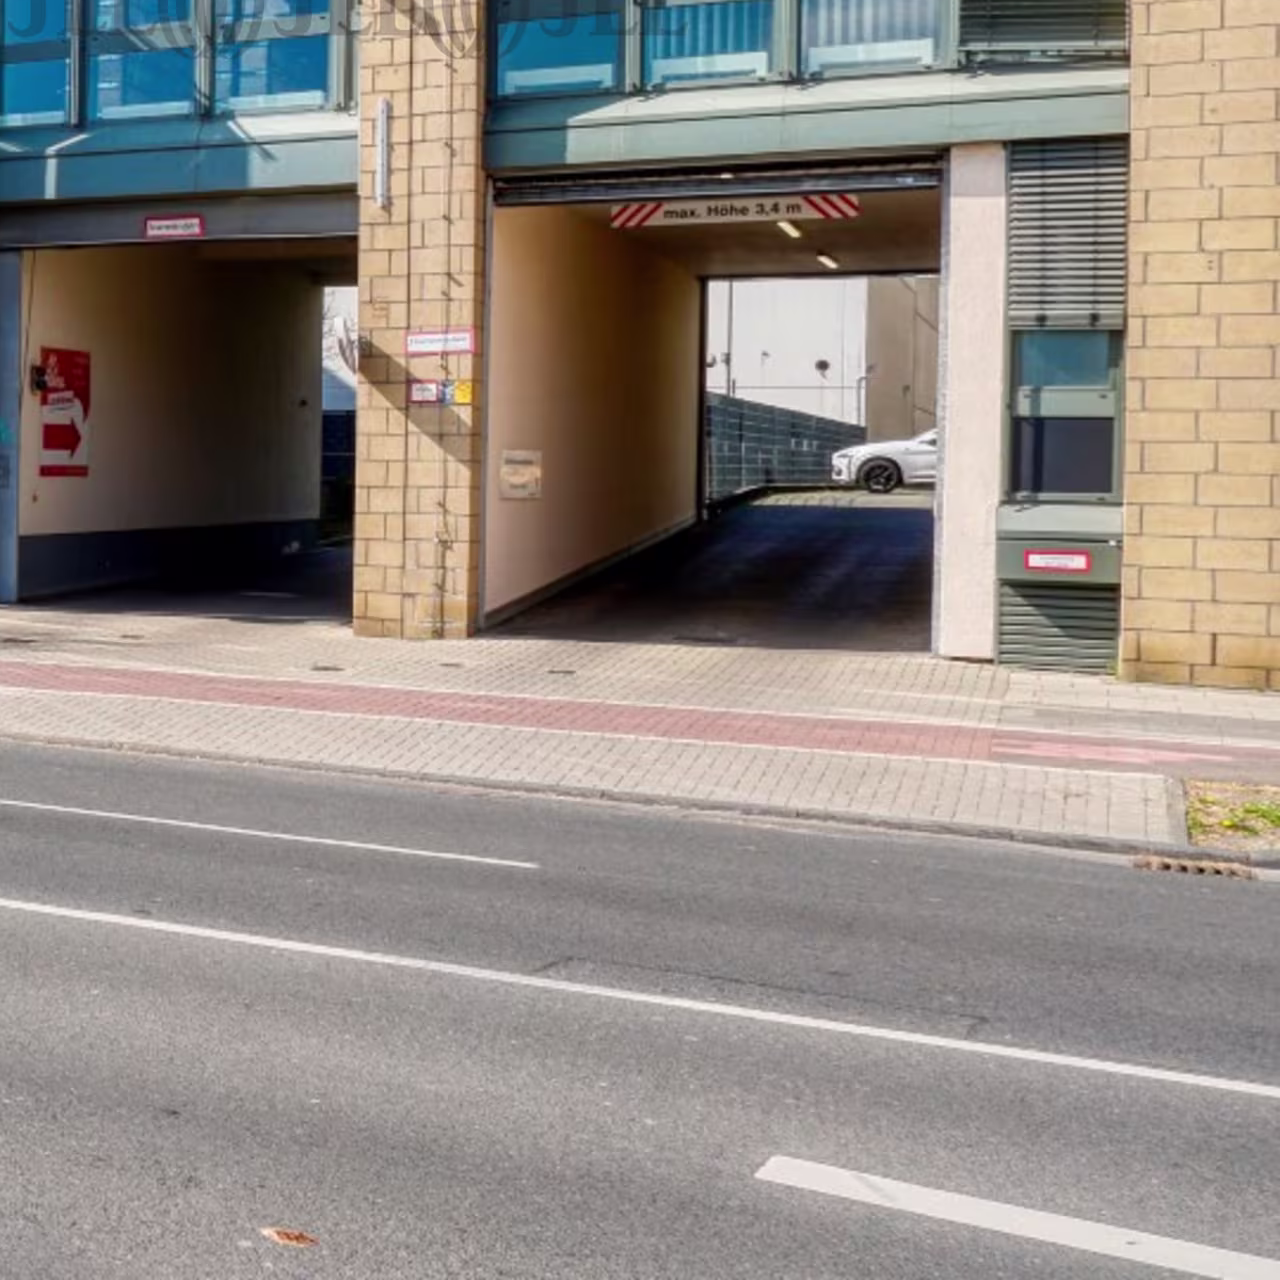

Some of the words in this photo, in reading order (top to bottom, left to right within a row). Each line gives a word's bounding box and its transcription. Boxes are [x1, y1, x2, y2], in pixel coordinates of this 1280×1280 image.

[663, 207, 700, 220] max.
[706, 203, 750, 218] Höhe
[755, 202, 781, 216] 3,4
[785, 203, 802, 215] m
